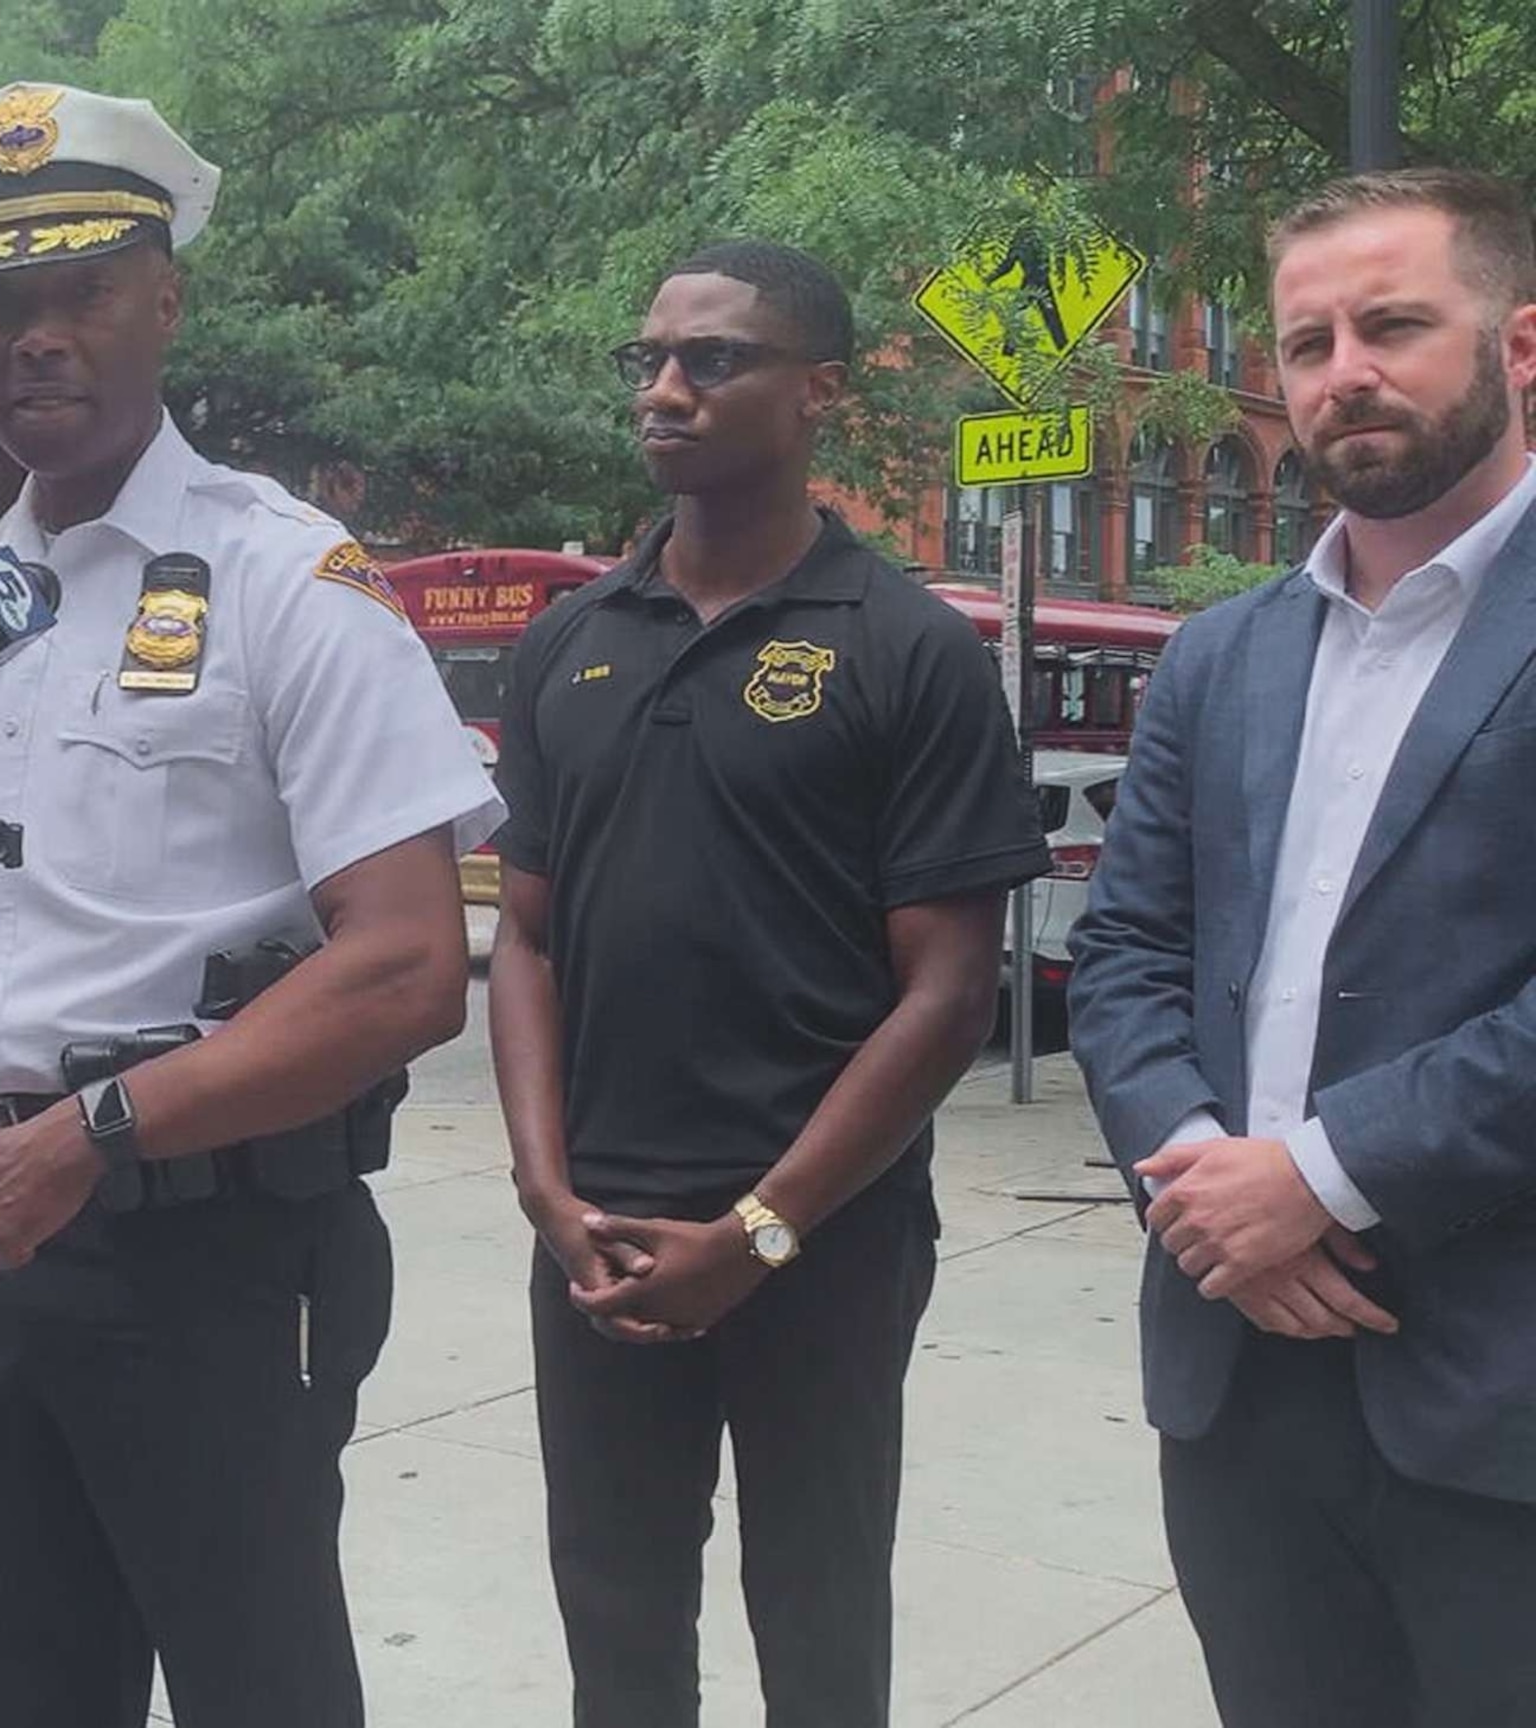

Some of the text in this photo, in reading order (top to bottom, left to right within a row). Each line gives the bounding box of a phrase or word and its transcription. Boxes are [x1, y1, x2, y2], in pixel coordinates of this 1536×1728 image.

[975, 425, 1074, 466] AHEAD
[424, 584, 533, 609] FUNNY BUS
